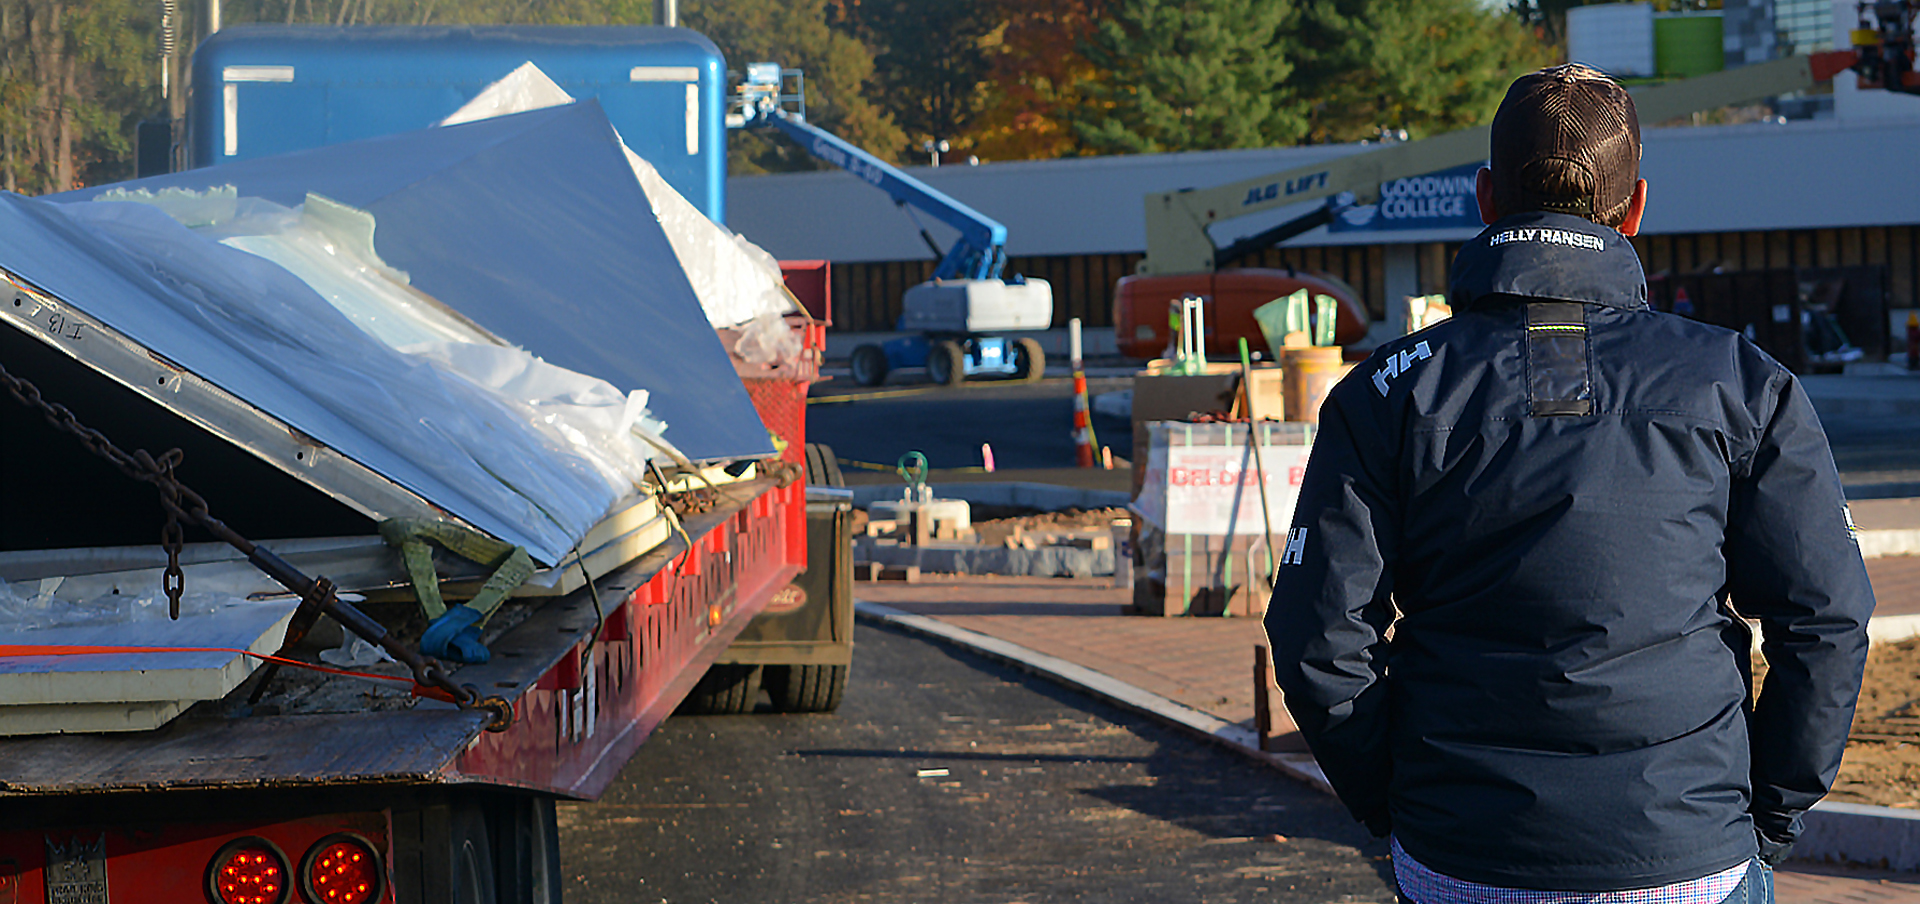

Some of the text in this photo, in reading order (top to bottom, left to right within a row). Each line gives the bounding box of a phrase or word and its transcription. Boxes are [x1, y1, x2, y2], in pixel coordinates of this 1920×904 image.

[1243, 171, 1329, 206] JLG LIFT
[1381, 176, 1477, 199] GOODWIN
[1381, 197, 1465, 220] COLLEGE
[1490, 228, 1604, 252] HELLY HANSEN
[1371, 340, 1433, 398] HH
